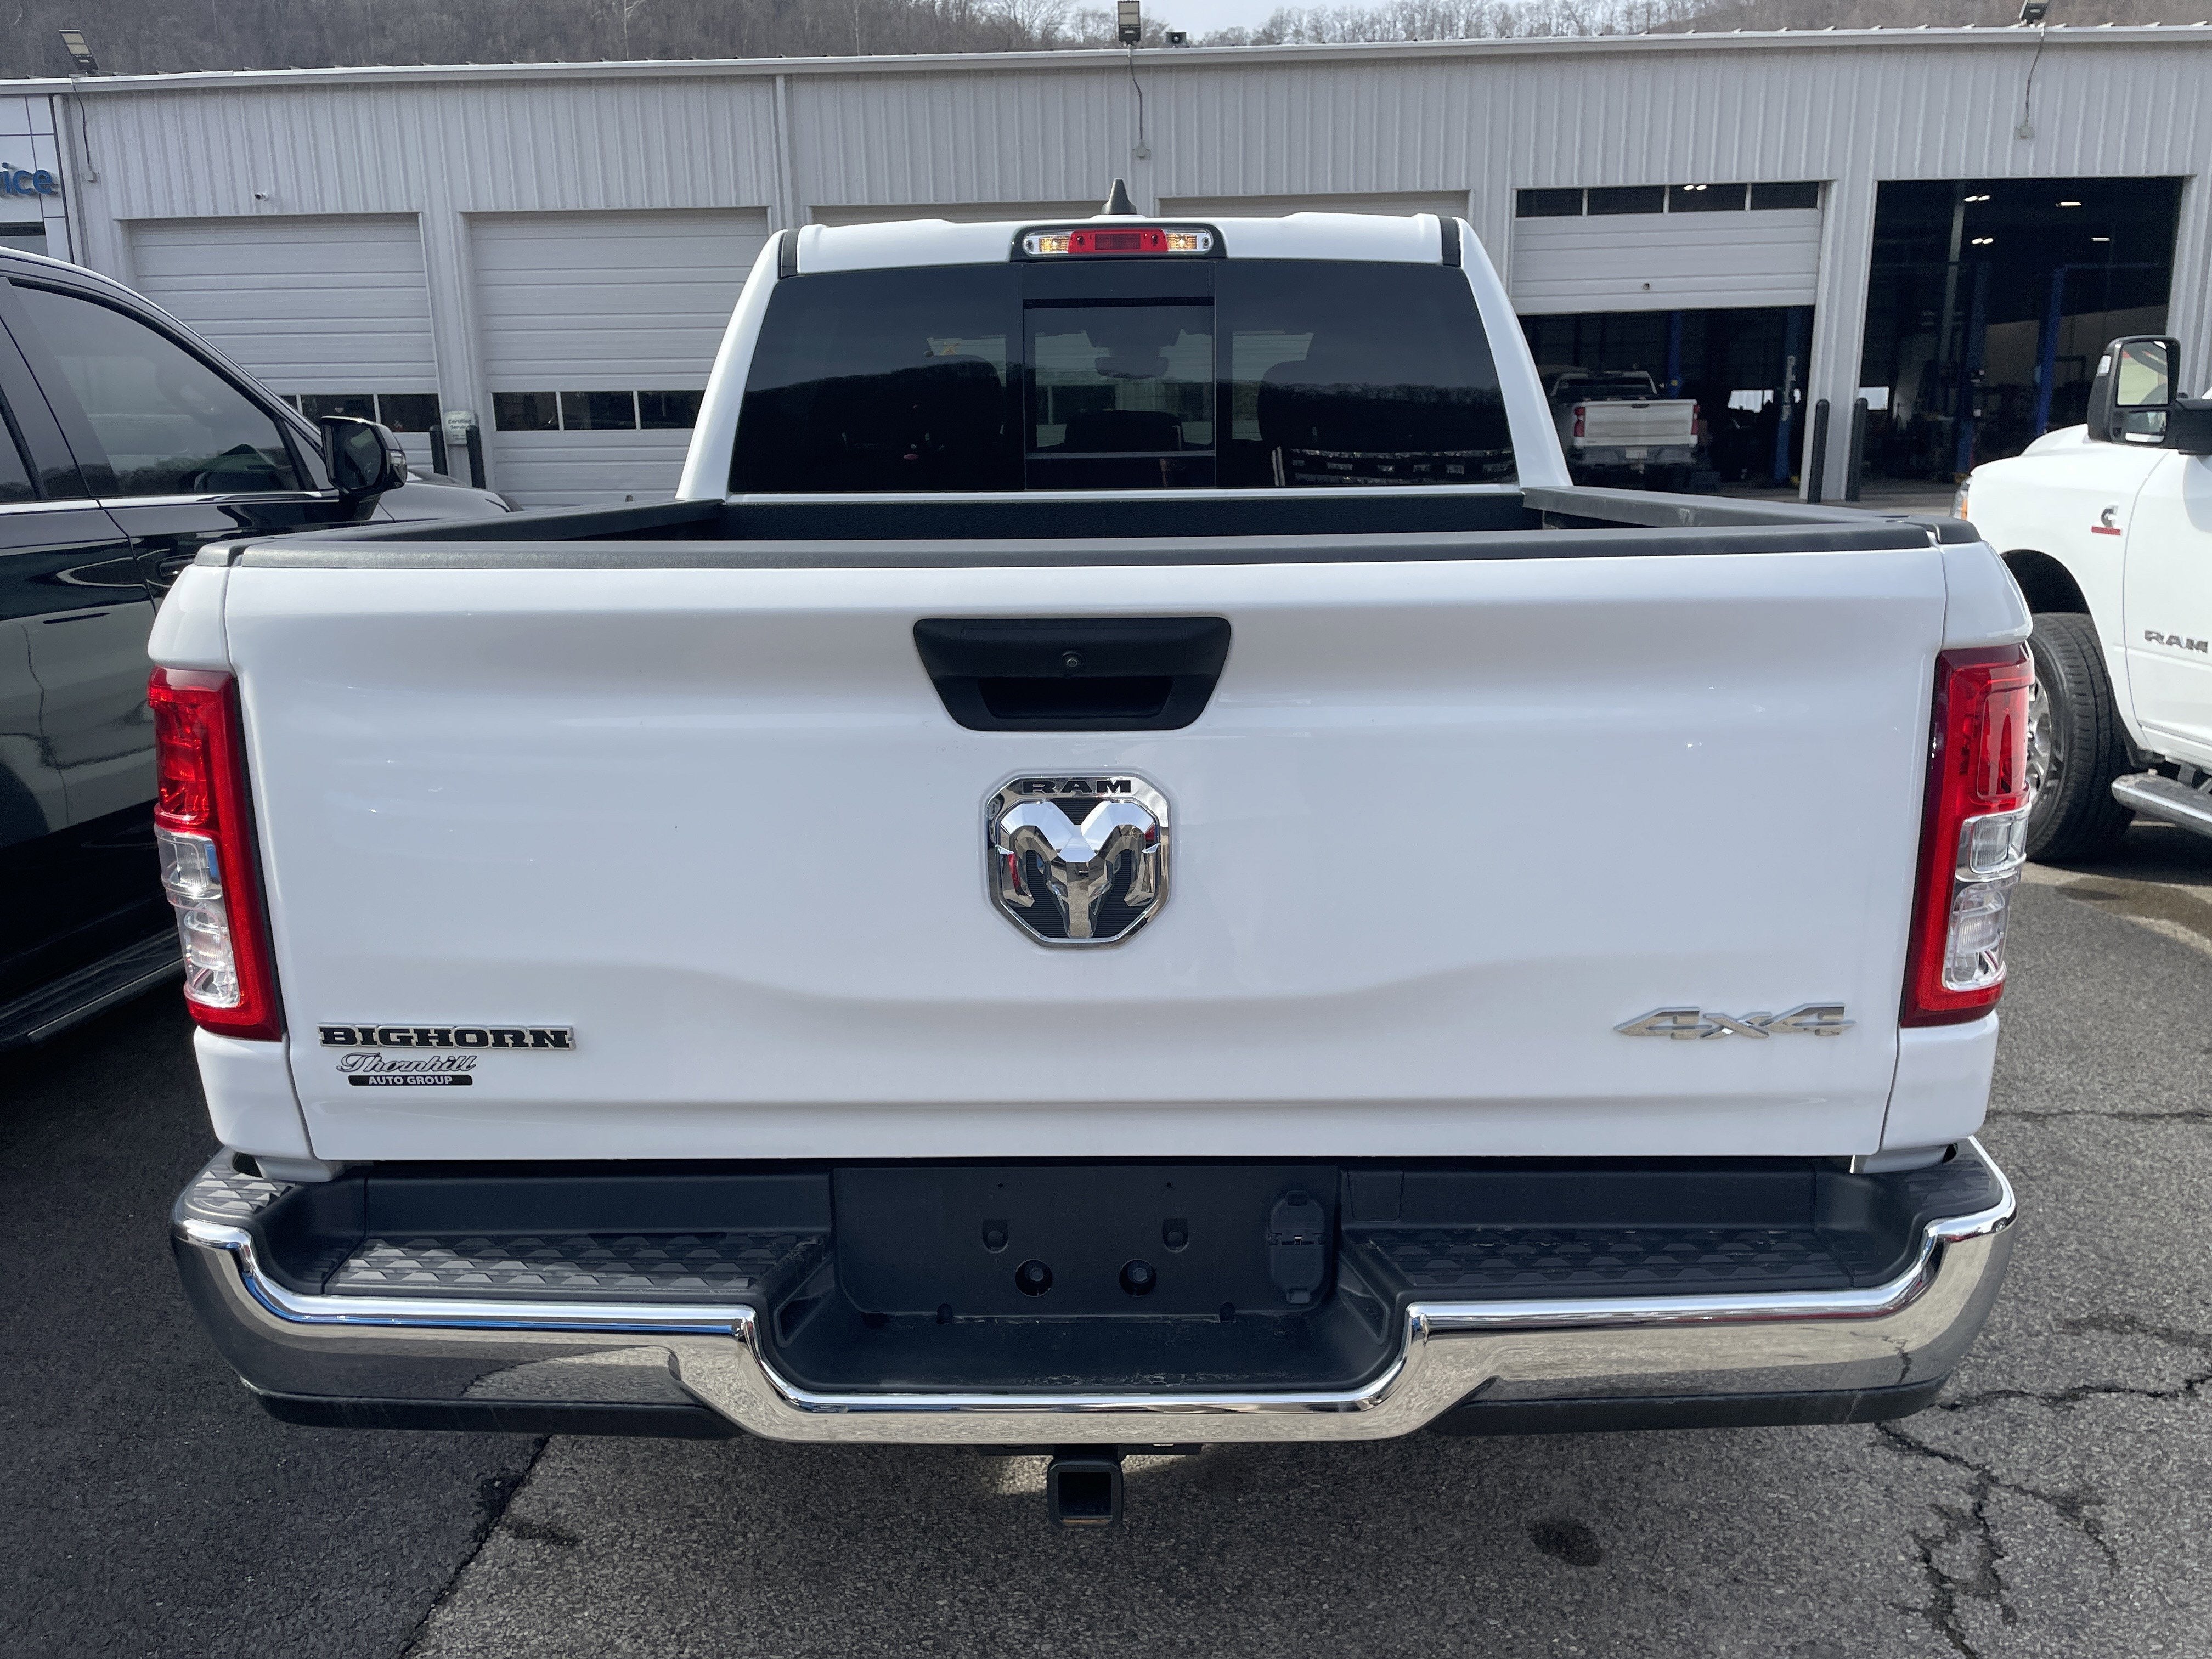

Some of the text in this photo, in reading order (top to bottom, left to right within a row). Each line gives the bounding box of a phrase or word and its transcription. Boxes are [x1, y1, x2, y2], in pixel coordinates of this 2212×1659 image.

[0, 162, 53, 195] ice
[2144, 629, 2209, 654] RAM
[1022, 780, 1132, 794] RAM
[318, 1025, 574, 1049] BIGHORN
[336, 1052, 477, 1073] Thornhill
[369, 1076, 453, 1085] AUTO GROUP
